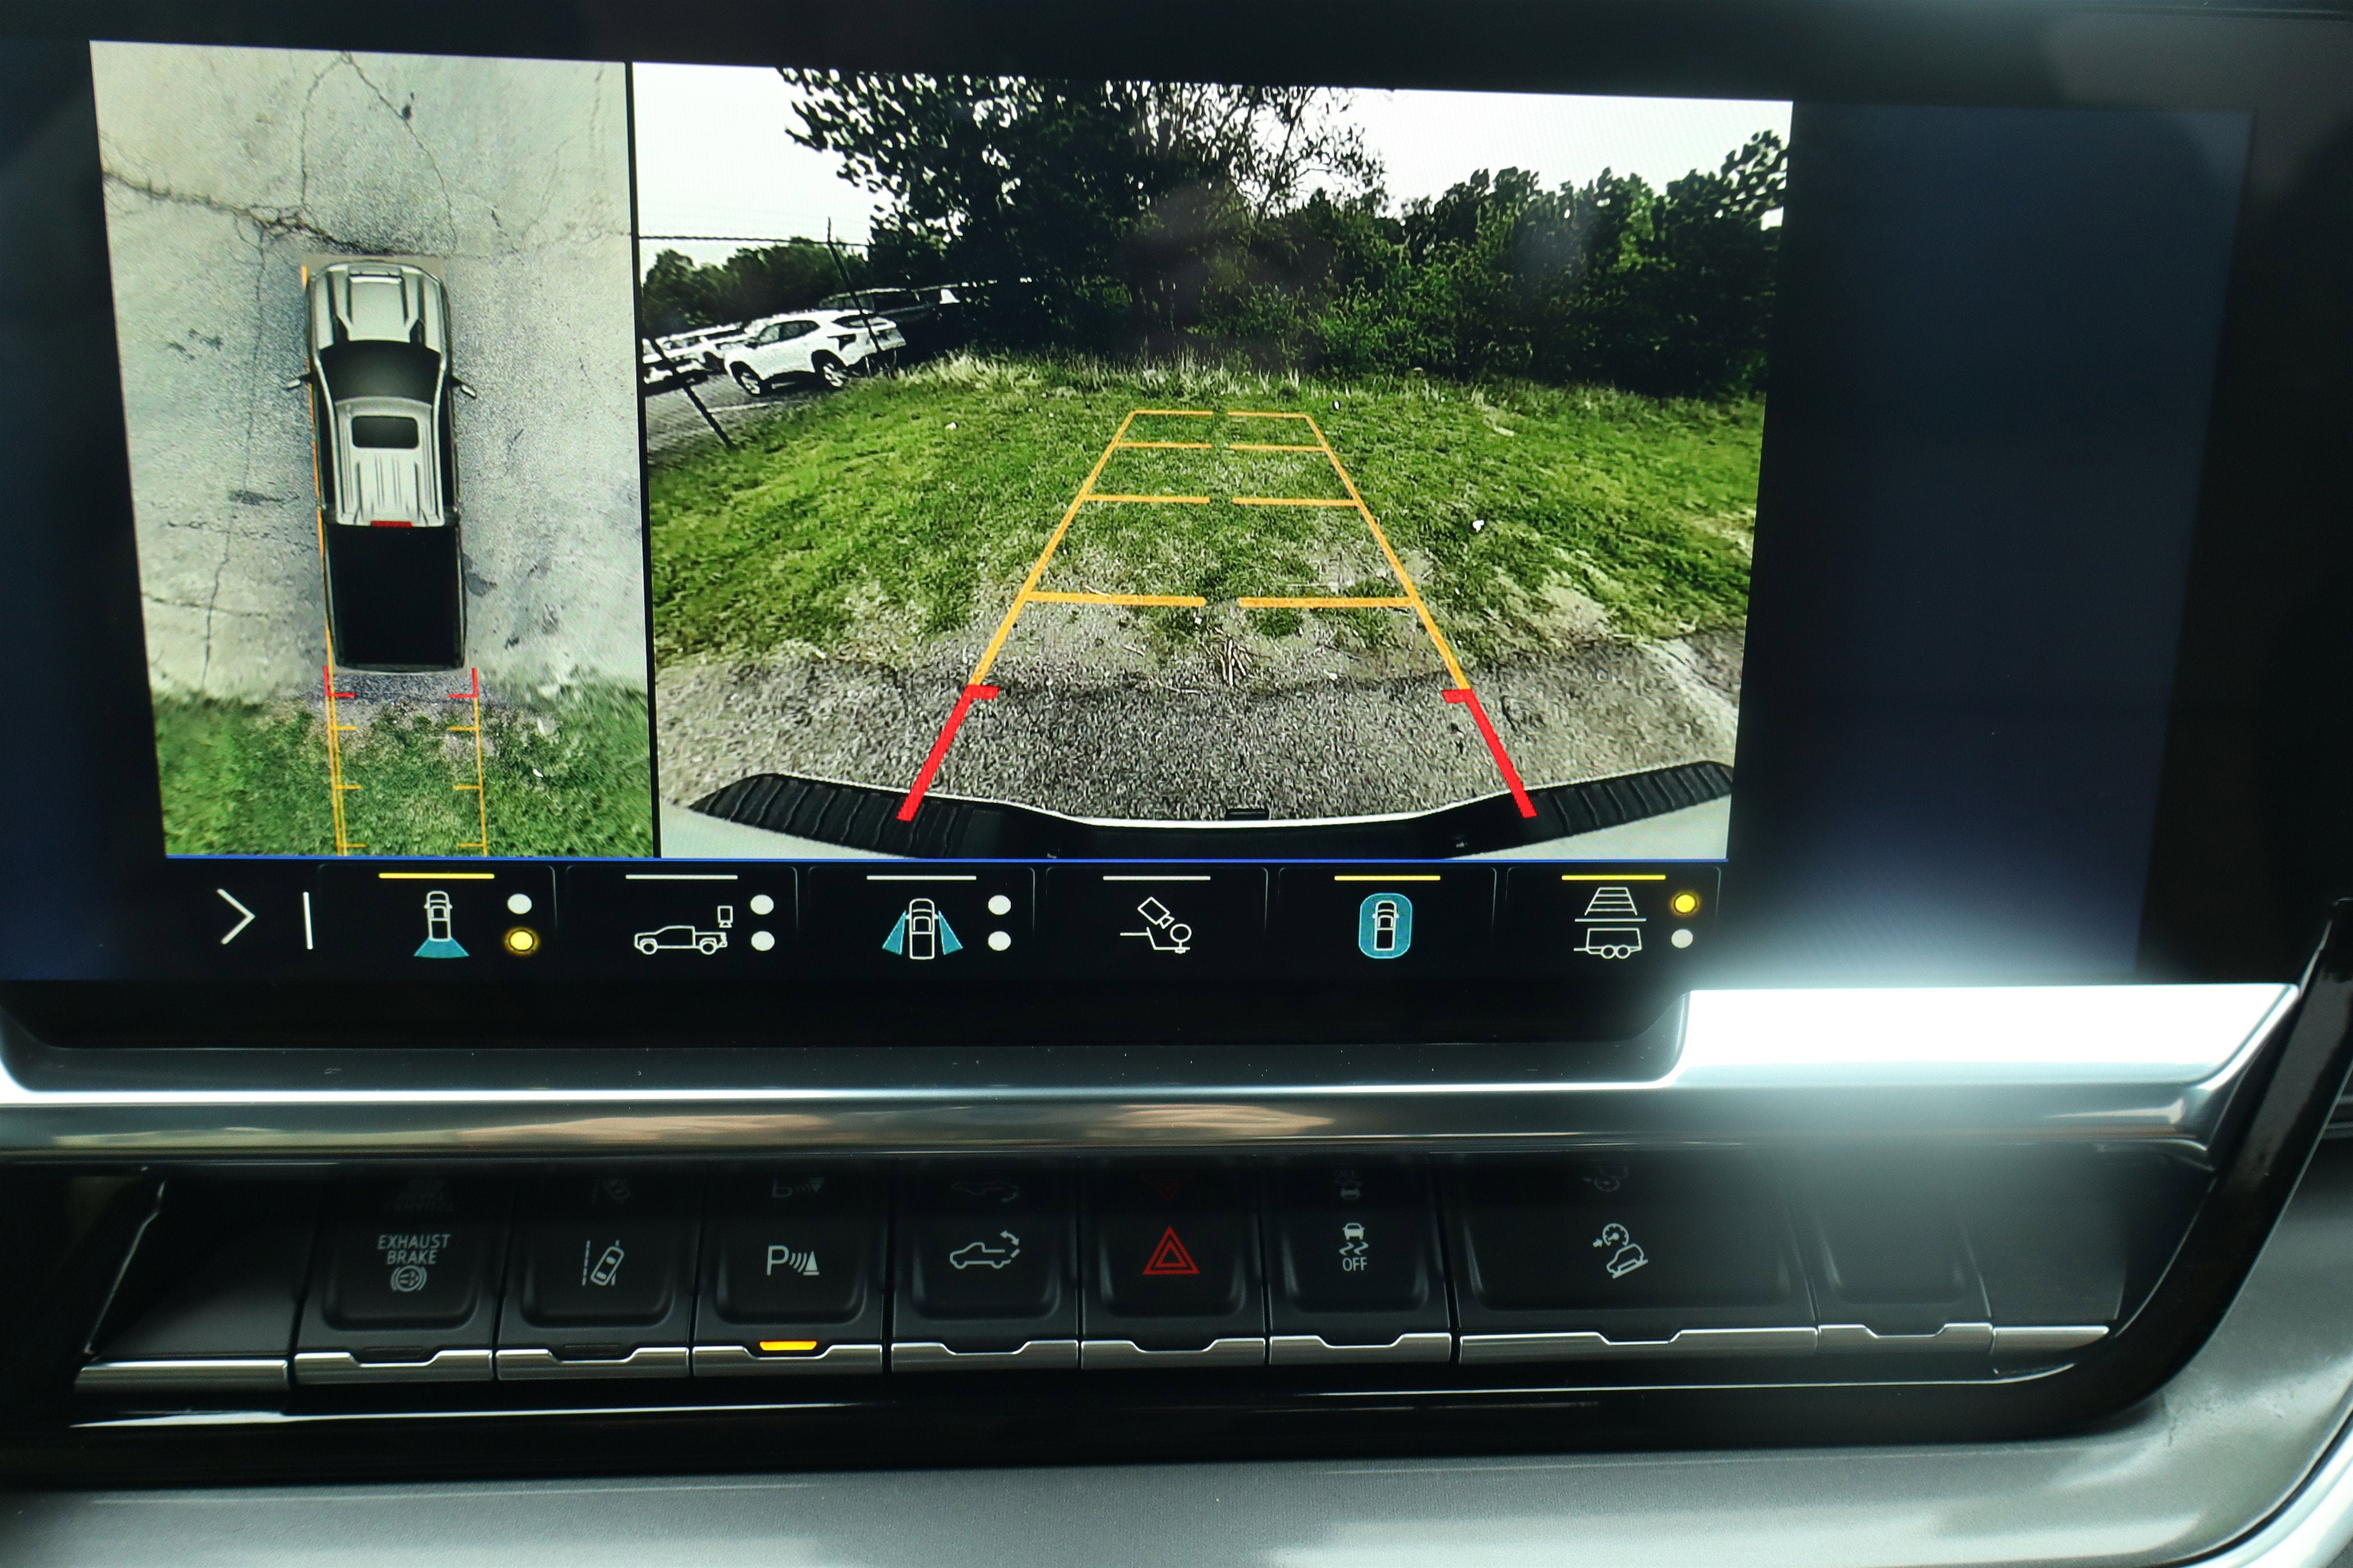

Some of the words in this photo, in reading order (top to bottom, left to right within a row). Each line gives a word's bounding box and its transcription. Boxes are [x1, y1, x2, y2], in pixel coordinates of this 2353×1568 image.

[377, 1234, 451, 1249] EXHAUST
[387, 1249, 438, 1265] BRAKE
[766, 1245, 789, 1276] P
[1342, 1257, 1368, 1272] OFF
